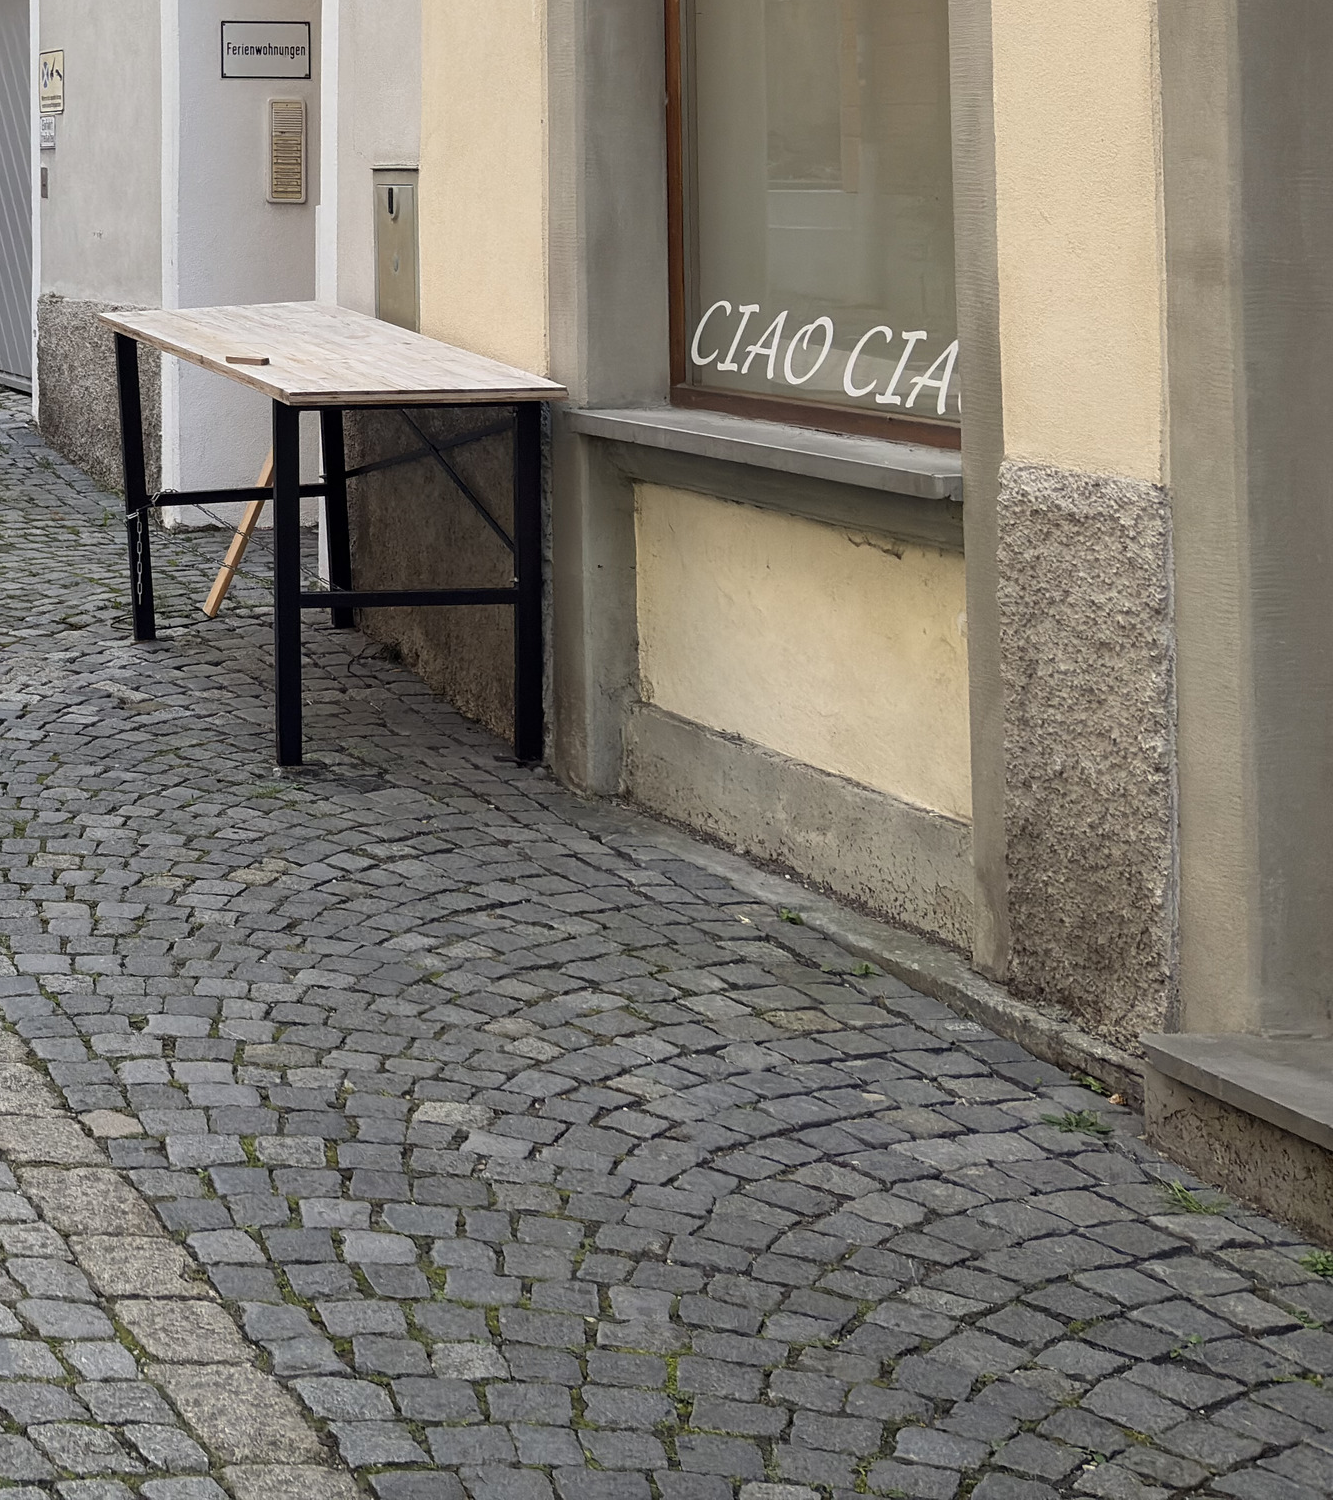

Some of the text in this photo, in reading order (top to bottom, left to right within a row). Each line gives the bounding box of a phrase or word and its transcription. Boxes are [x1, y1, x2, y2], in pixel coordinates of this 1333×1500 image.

[226, 42, 306, 60] Ferienwohnungen
[691, 300, 962, 415] CIAO CIA
